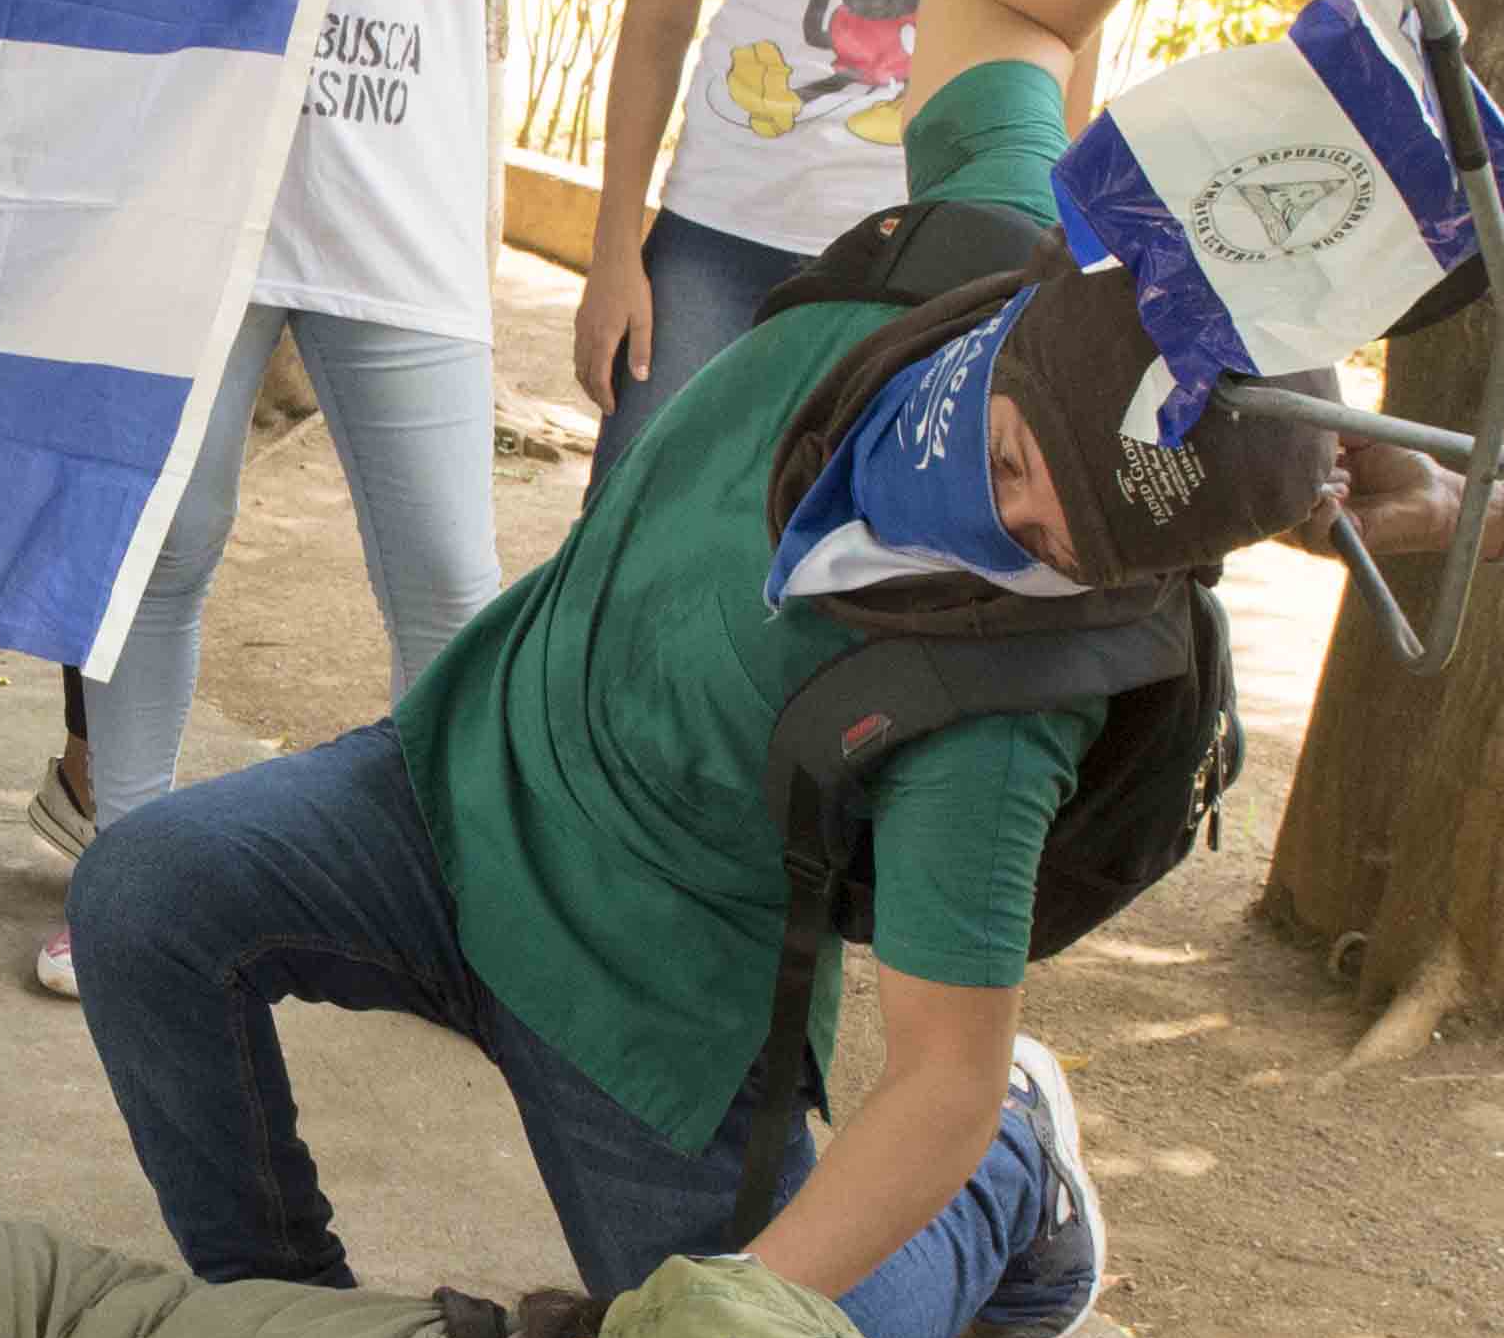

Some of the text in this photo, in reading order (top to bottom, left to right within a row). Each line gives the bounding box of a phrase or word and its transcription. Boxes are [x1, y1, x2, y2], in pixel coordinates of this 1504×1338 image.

[313, 13, 421, 74] BUSCA
[301, 65, 409, 125] SINO
[1119, 436, 1145, 481] GLOR
[1140, 483, 1170, 525] FADED
